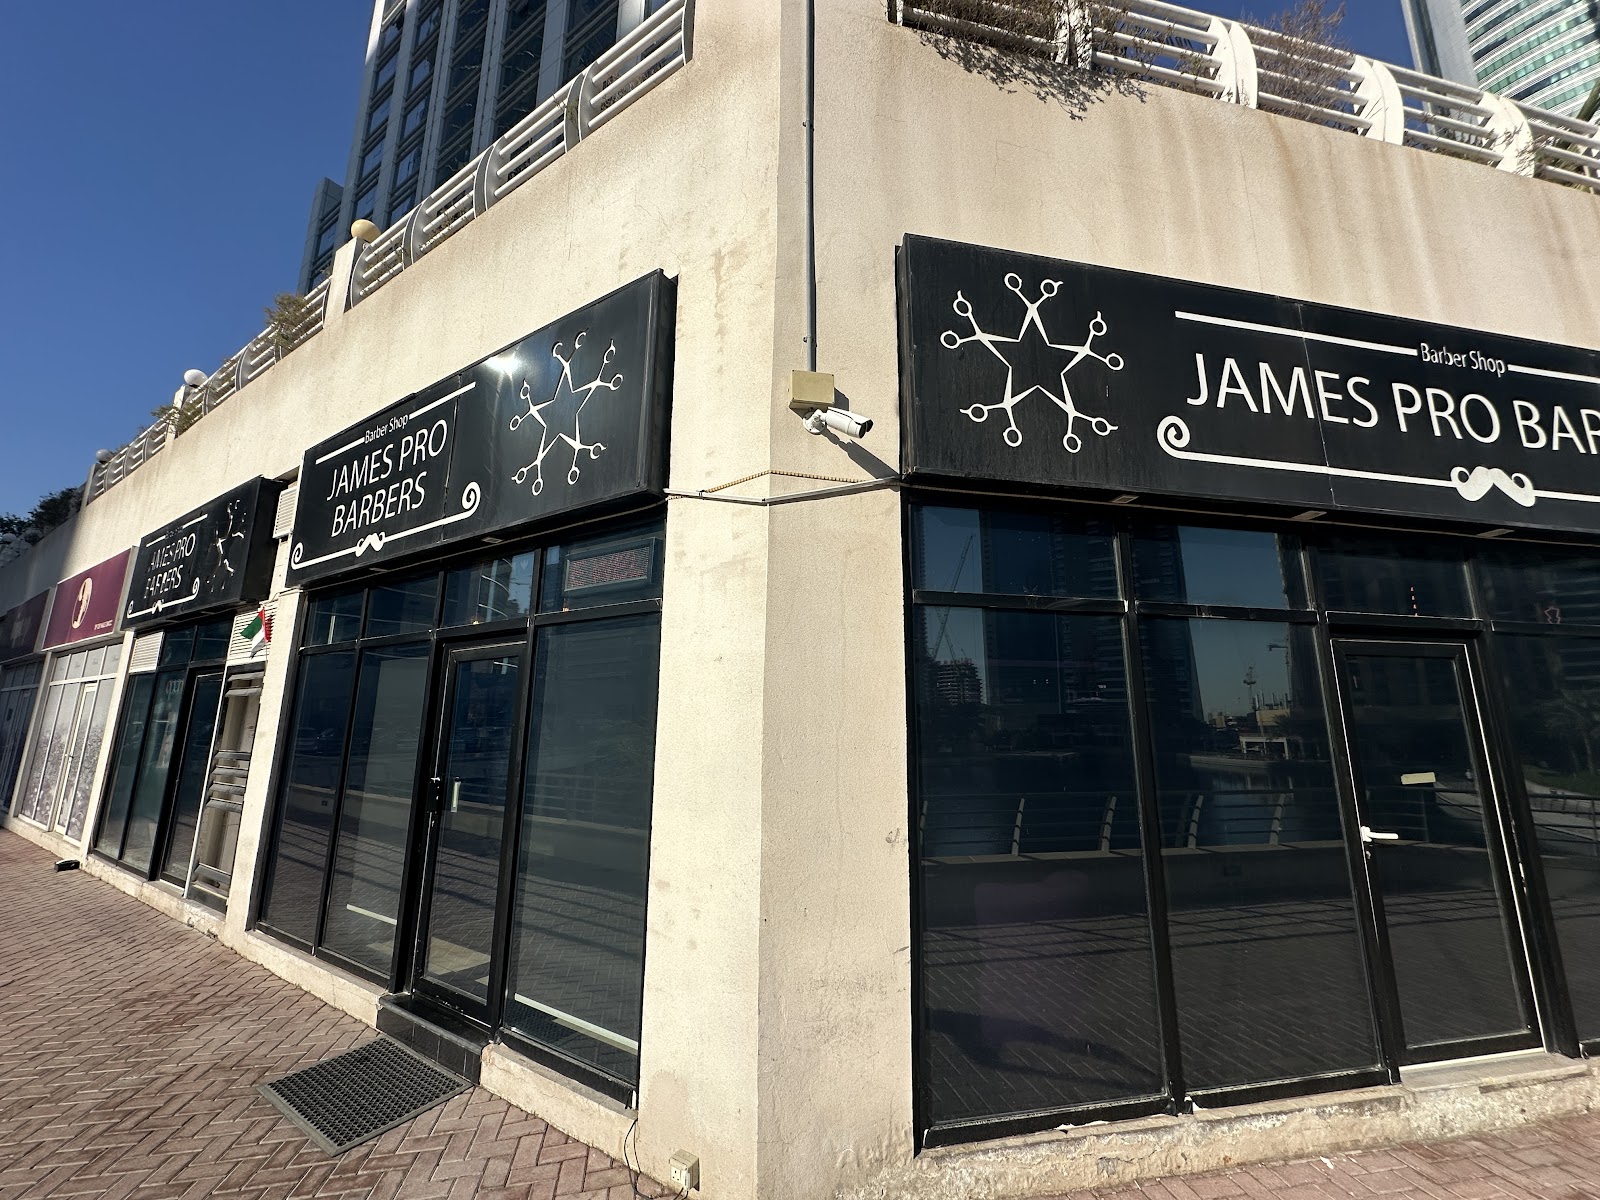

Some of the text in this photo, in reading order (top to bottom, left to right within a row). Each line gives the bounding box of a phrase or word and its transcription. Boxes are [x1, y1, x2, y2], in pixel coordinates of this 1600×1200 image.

[1420, 342, 1506, 377] Barber Shop
[1187, 353, 1379, 428] JAMES
[1391, 382, 1501, 443] PRO
[364, 413, 409, 444] Barber Shop
[326, 419, 448, 501] JAMES PRO
[331, 471, 428, 538] BARBERS
[147, 543, 176, 573] AMES
[173, 532, 196, 561] PRO
